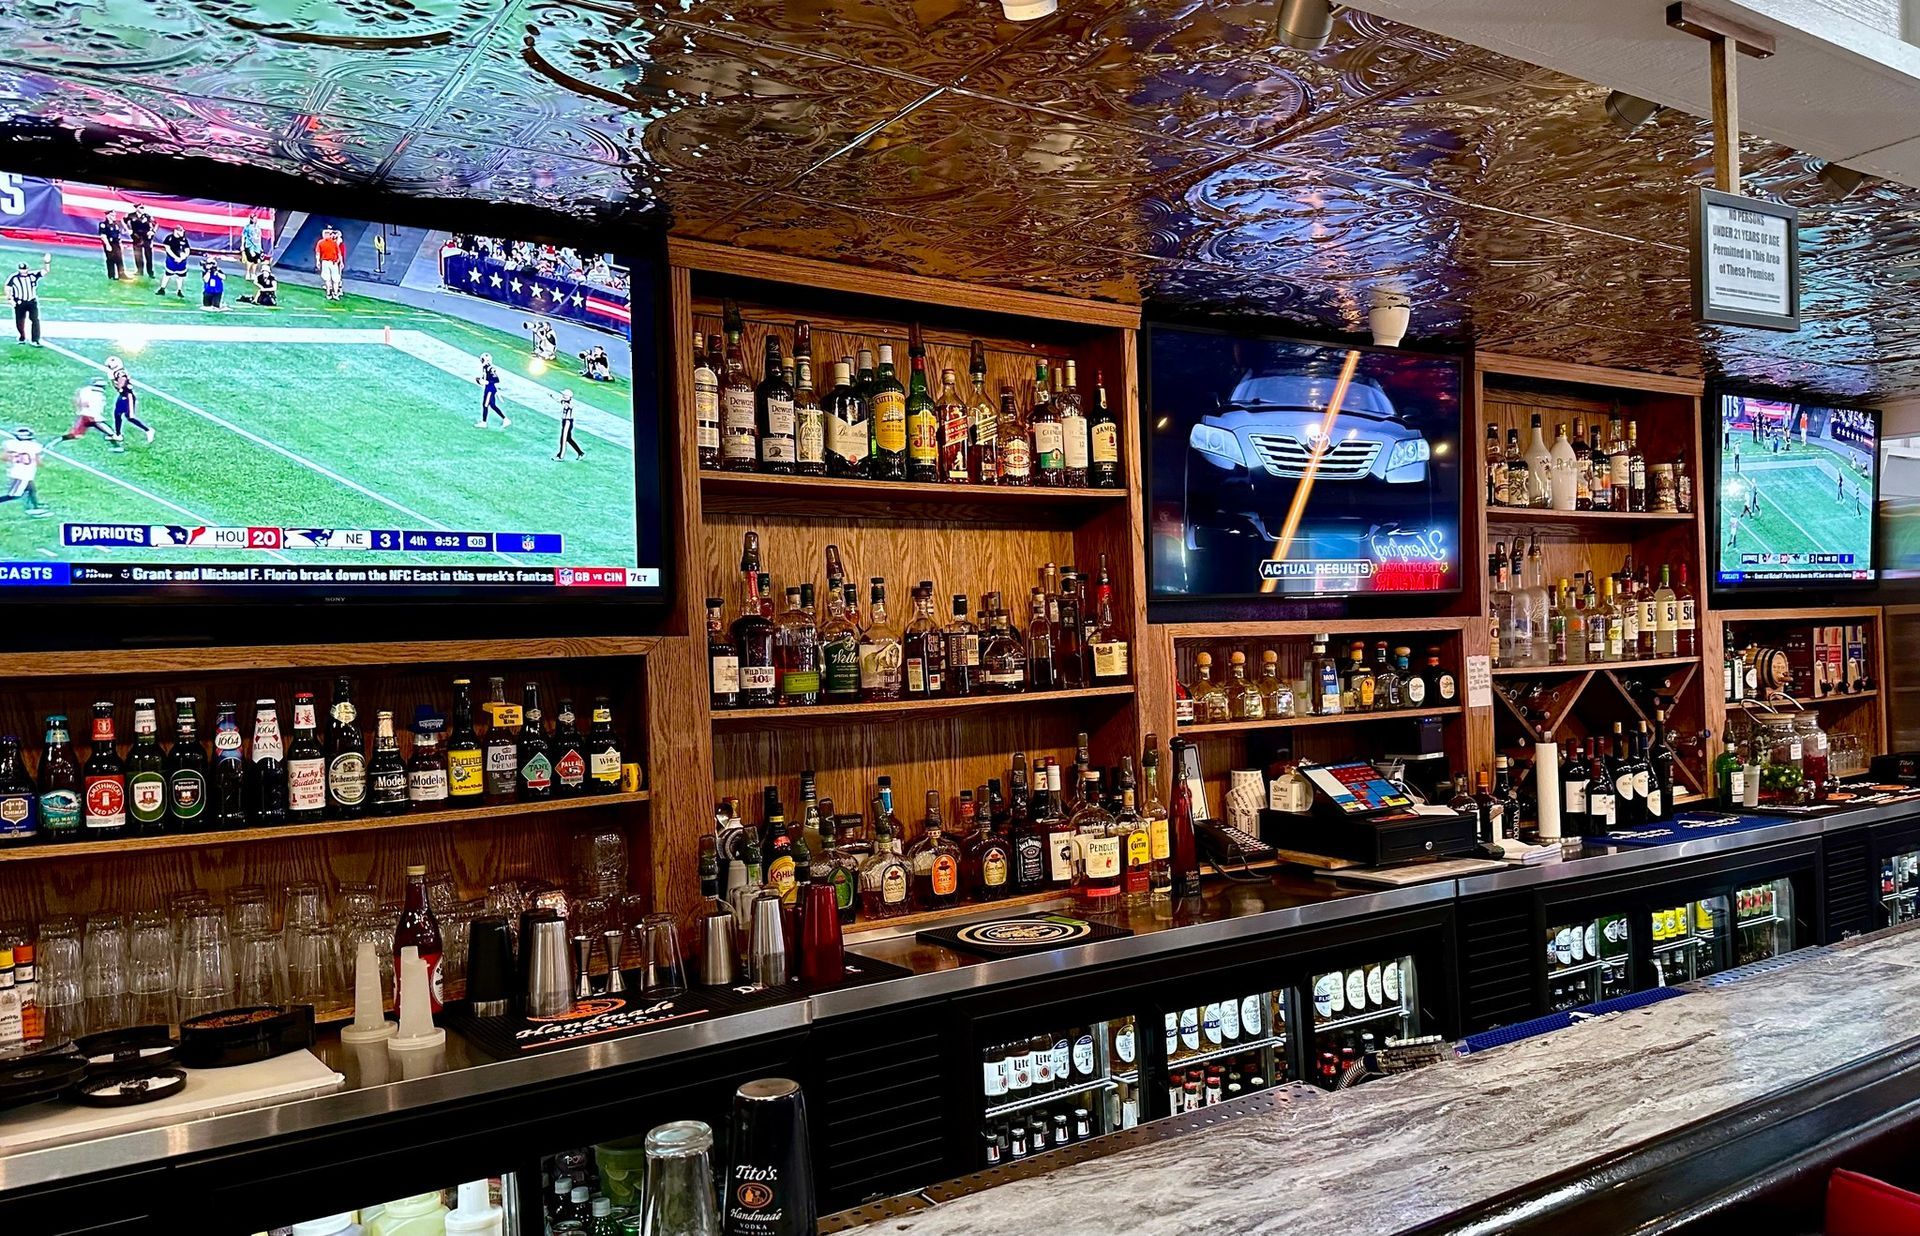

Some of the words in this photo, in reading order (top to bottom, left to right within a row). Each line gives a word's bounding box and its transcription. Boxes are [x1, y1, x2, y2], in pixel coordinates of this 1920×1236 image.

[1738, 210, 1765, 226] PERSONS
[1712, 225, 1733, 239] UNDER
[1742, 230, 1761, 243] YEARS
[1768, 235, 1780, 247] AGE
[1713, 243, 1744, 260] Permitted
[1752, 250, 1765, 262] This
[1766, 252, 1780, 264] Area
[1726, 264, 1746, 277] These
[1746, 267, 1775, 282] Premises
[71, 526, 144, 544] PATRIOTS
[215, 530, 245, 542] HOU
[252, 531, 276, 546] 20
[345, 533, 363, 545] NE
[379, 533, 391, 547] 3
[409, 535, 427, 546] 4th
[435, 536, 460, 547] 9:52
[133, 567, 172, 581] Grant
[175, 568, 199, 581] and
[202, 568, 248, 581] Michael
[250, 569, 262, 581] F.
[264, 569, 298, 581] Florio
[300, 569, 333, 582] break
[335, 569, 366, 582] down
[368, 569, 388, 582] the
[389, 570, 412, 582] NFC
[413, 570, 438, 582] East
[440, 570, 451, 582] in
[452, 570, 475, 582] this
[476, 570, 515, 582] week's
[516, 570, 554, 583] fantas
[1264, 563, 1313, 576] ACTUAL
[1315, 563, 1370, 574] RESULTS
[603, 571, 623, 582] CIN
[218, 736, 240, 746] 1664
[297, 770, 320, 779] Lucky
[413, 775, 442, 786] Modelo
[292, 779, 322, 788] Buddha
[94, 806, 105, 816] RED
[106, 805, 119, 815] ALE
[516, 1001, 674, 1039] Handmade
[730, 1208, 783, 1222] Handmade
